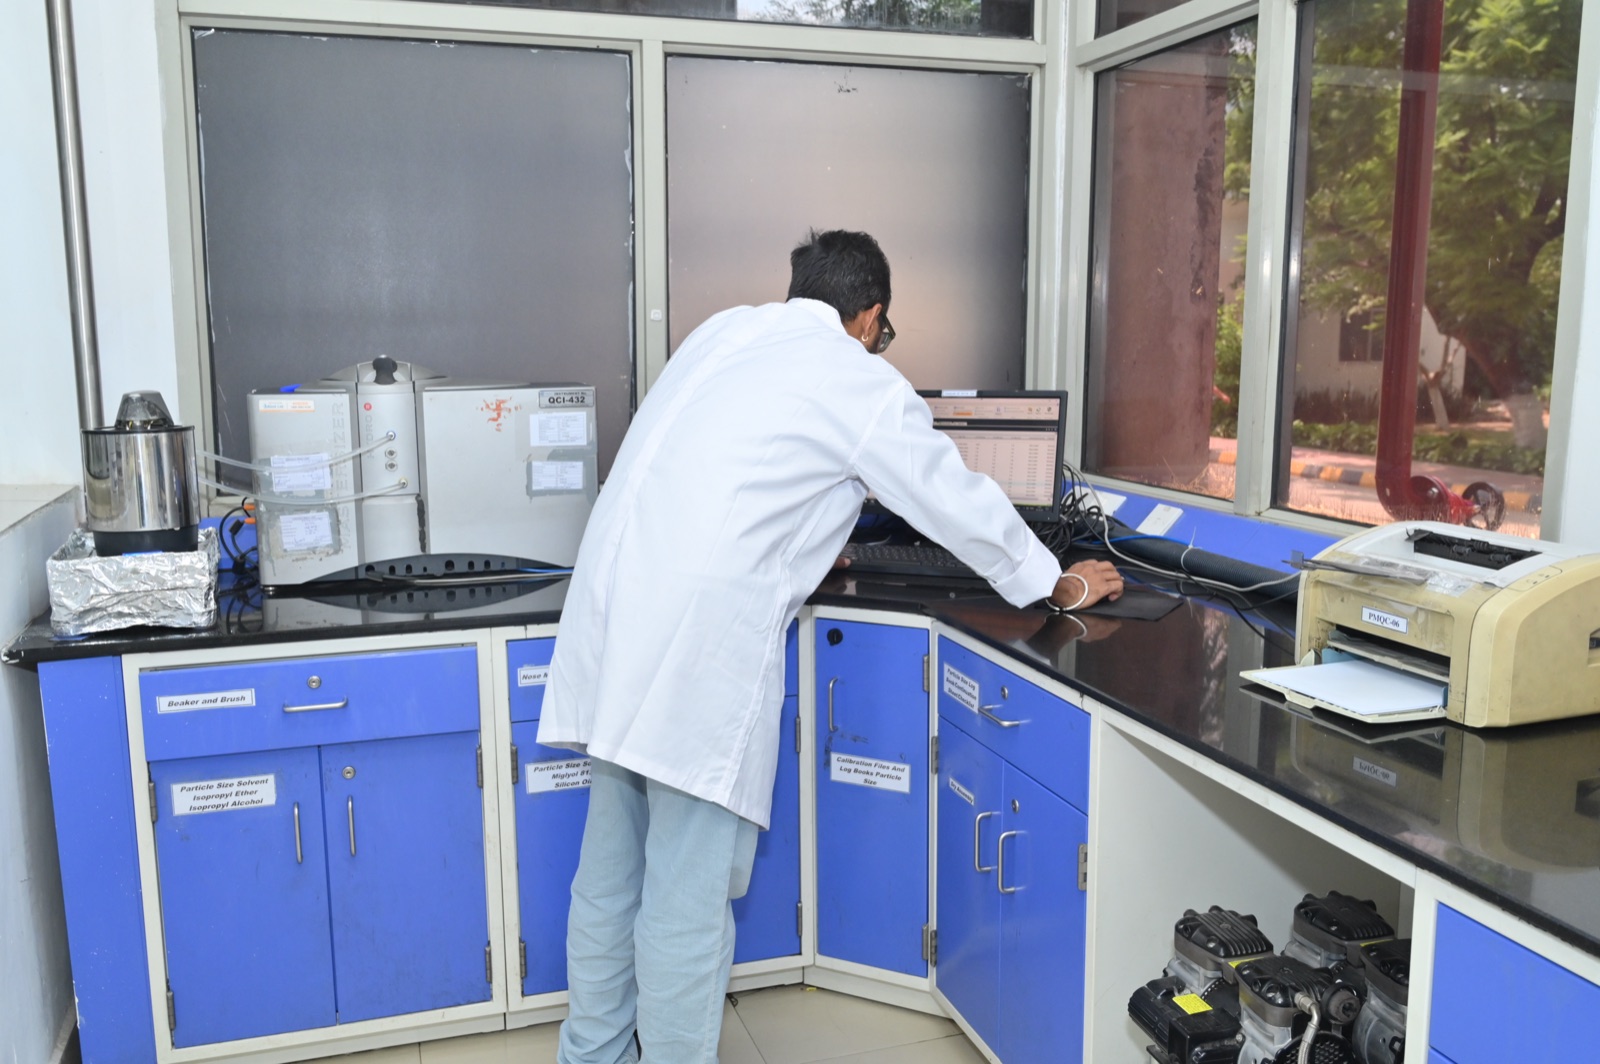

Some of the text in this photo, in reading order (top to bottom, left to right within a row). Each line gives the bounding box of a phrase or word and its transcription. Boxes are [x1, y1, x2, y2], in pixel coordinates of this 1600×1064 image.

[548, 396, 586, 404] QCI-432
[365, 414, 375, 460] HDRO
[332, 402, 351, 549] MASERIZER
[1368, 612, 1400, 627] PMQC-06
[522, 673, 542, 681] Nose
[968, 681, 976, 691] Log
[167, 698, 199, 707] Beaker
[220, 695, 246, 703] Brush
[533, 765, 563, 773] Particle
[836, 756, 872, 767] Calibration
[873, 762, 890, 770] Files
[551, 771, 578, 779] Miglyol
[853, 768, 874, 776] Books
[875, 772, 902, 780] Particle
[180, 783, 214, 792] Particle
[236, 778, 269, 787] Solvent
[192, 789, 258, 801] Isopropyl Ether
[188, 798, 264, 811] Isopropyl Alcohol
